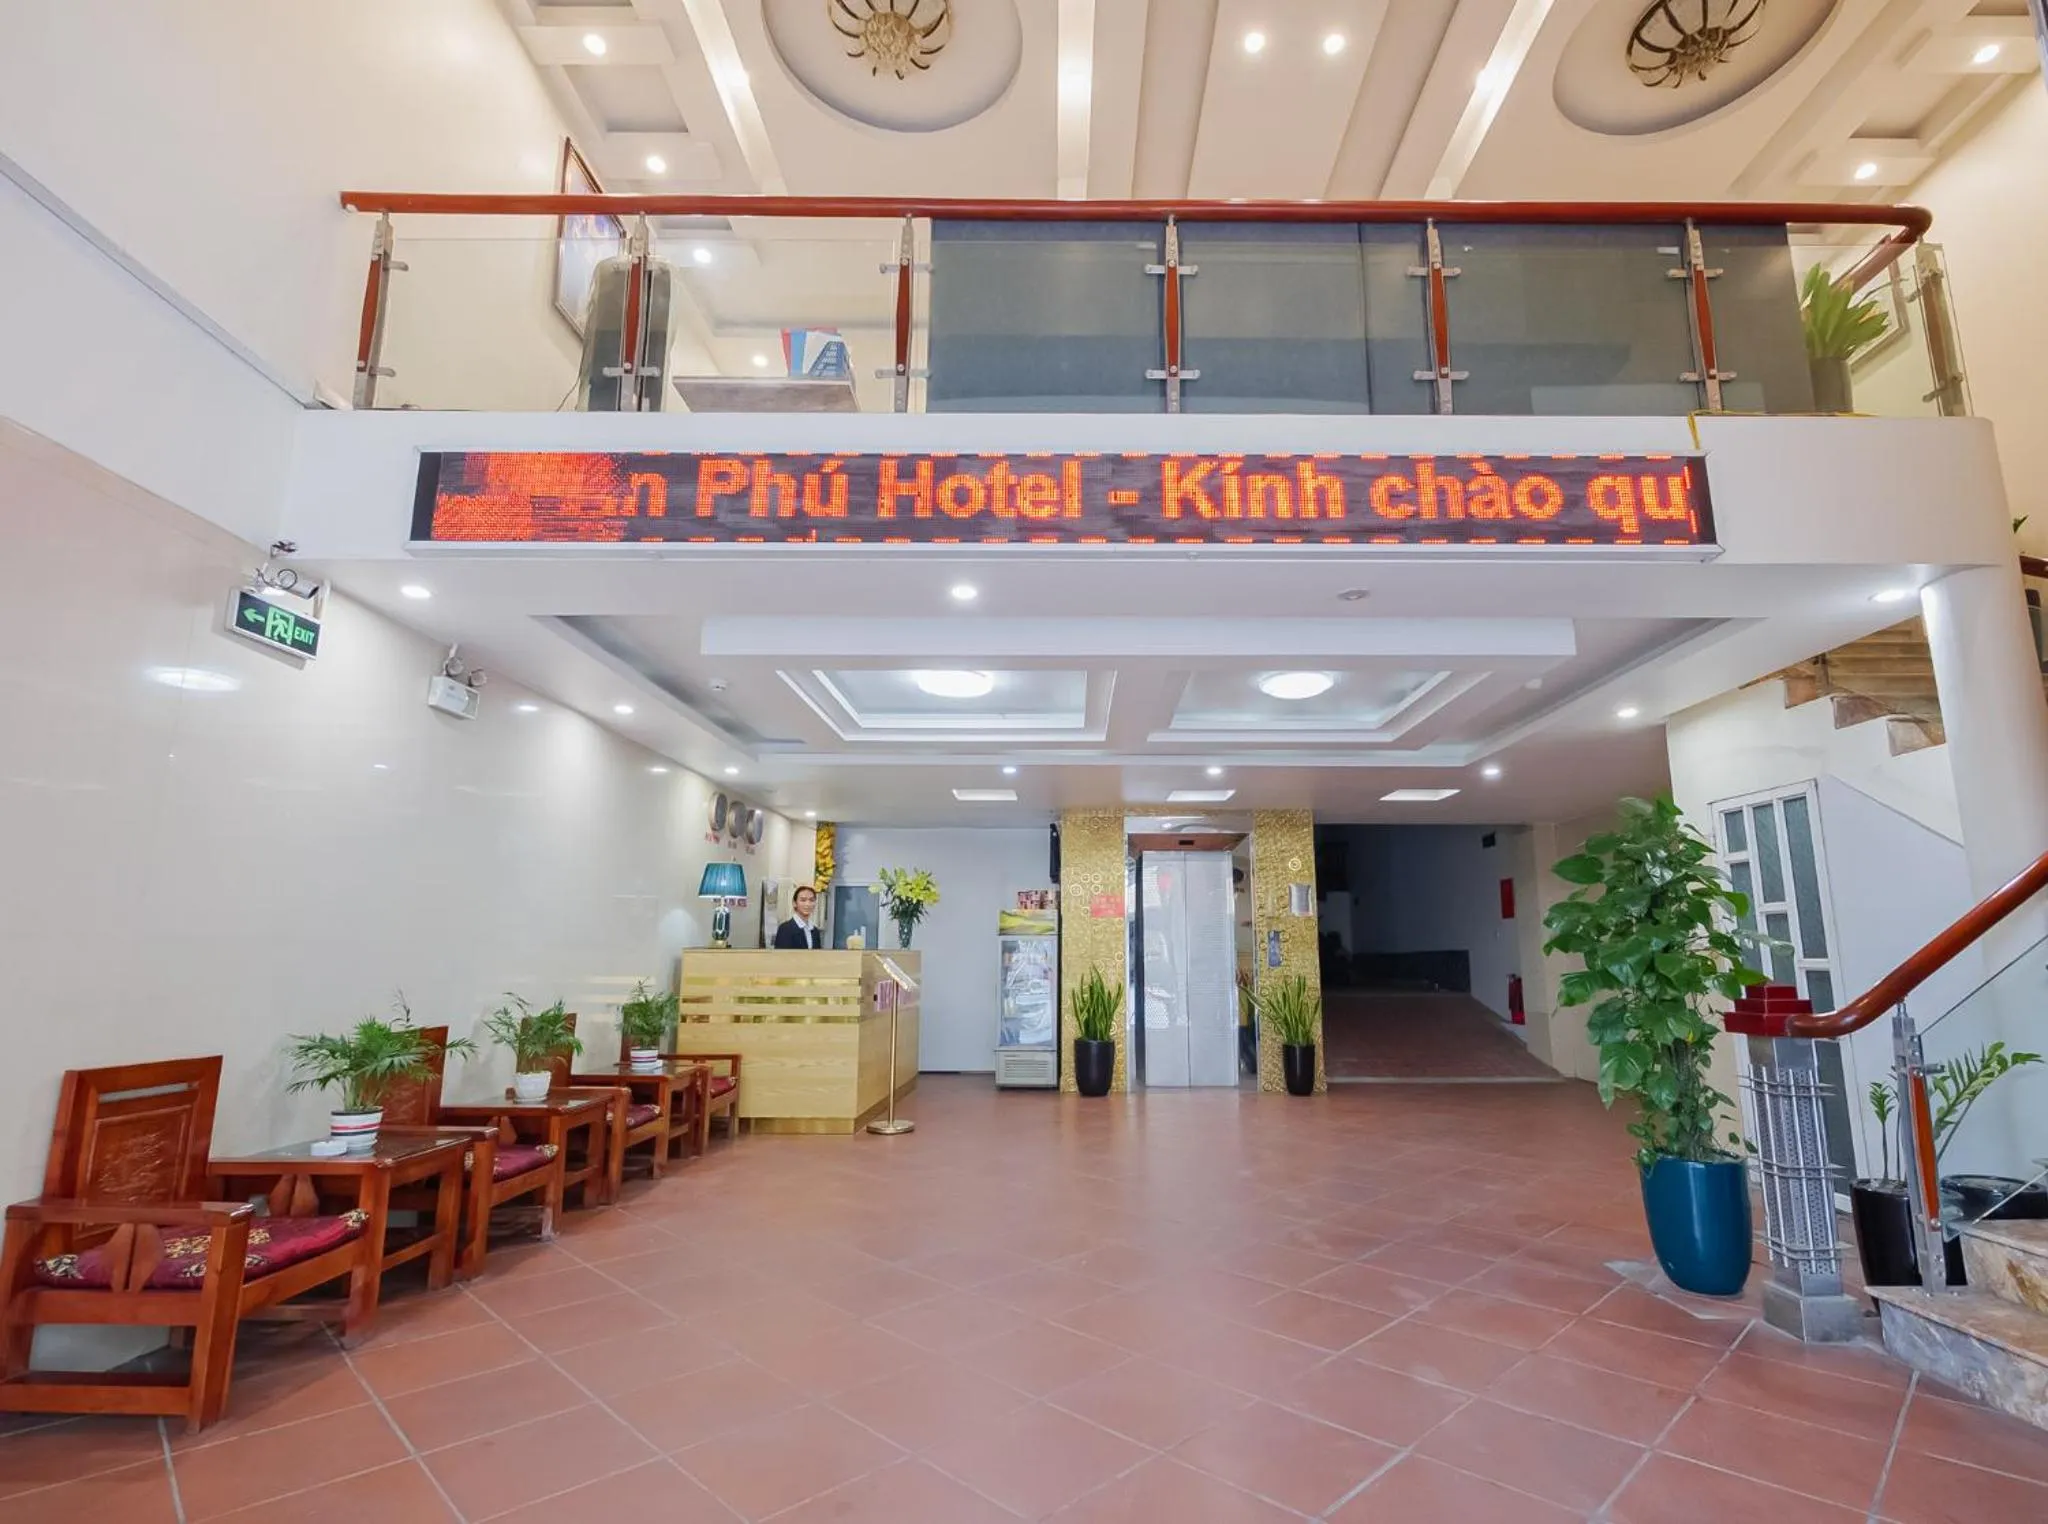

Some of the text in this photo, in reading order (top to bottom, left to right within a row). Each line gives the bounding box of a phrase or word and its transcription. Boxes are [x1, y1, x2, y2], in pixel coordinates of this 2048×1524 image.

[696, 459, 848, 517] Phú
[877, 460, 1081, 518] Hotel
[1162, 460, 1345, 518] Kính
[1370, 460, 1565, 520] chào
[1587, 475, 1687, 533] qu
[294, 626, 315, 645] EXIT
